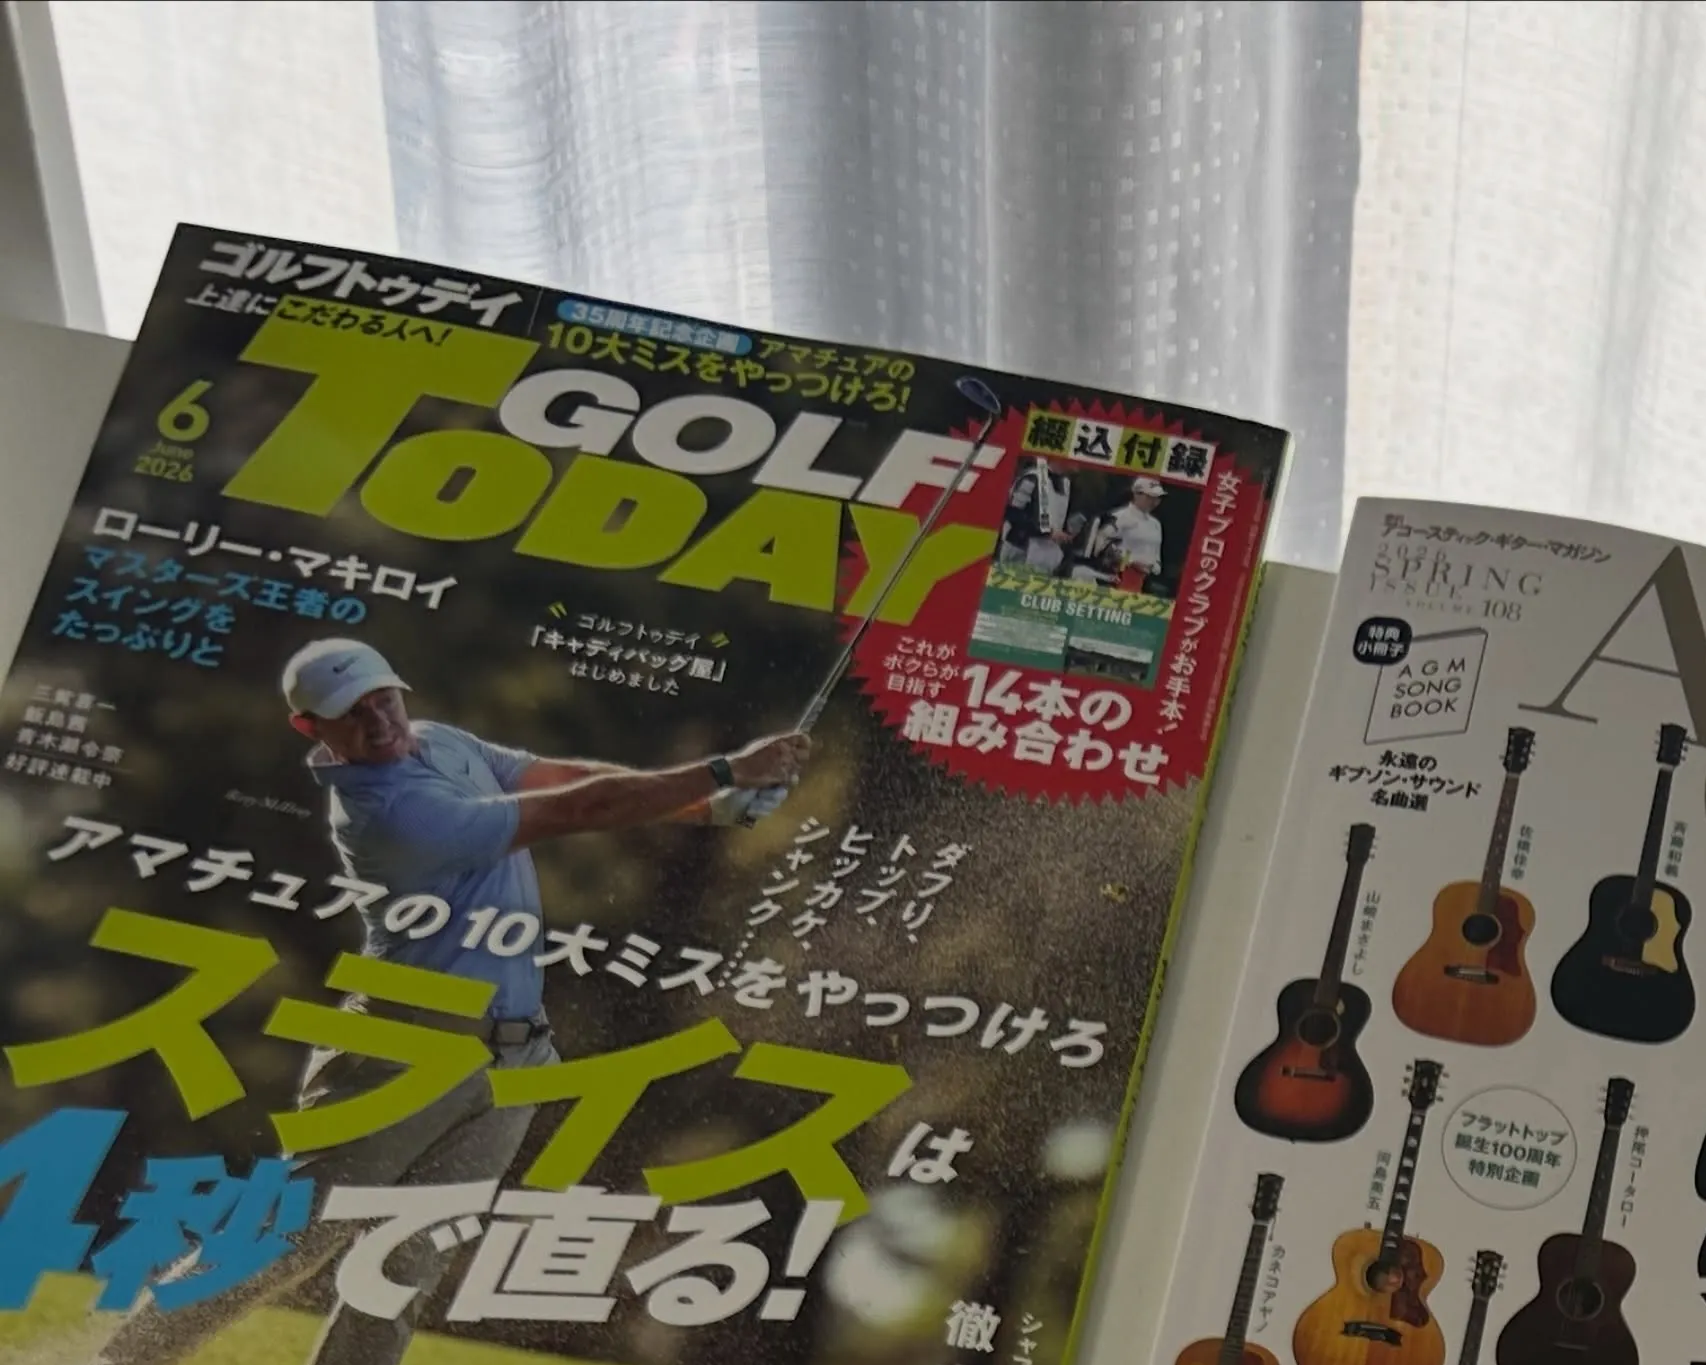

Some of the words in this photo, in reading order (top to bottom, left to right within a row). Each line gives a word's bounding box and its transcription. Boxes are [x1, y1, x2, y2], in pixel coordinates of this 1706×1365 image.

[198, 239, 523, 328] ゴルフトゥデイ
[157, 379, 211, 441] 6
[499, 369, 1005, 509] GOLF
[1024, 412, 1215, 482] 綴込付録
[134, 457, 194, 483] 2026
[221, 294, 1000, 627] TODAY
[92, 506, 458, 610] ローリー・マキロイ
[1374, 557, 1544, 598] SPRING
[66, 577, 237, 635] スイングを
[84, 545, 366, 626] マスターズ王者の
[1021, 595, 1061, 613] CLUB
[1065, 603, 1132, 626] SETTING
[1482, 599, 1523, 622] 108
[52, 609, 226, 668] たっぷりと
[897, 637, 957, 661] これが
[570, 662, 680, 695] はじめました
[883, 654, 960, 683] ボクらが
[886, 675, 946, 699] 目指す
[1394, 677, 1463, 700] SONG
[961, 664, 1133, 731] 14本の
[1390, 696, 1457, 720] BOOK
[903, 700, 1169, 784] 組み合わせ
[1379, 750, 1437, 772] 永遠の
[48, 815, 1107, 1068] アマチュアの10大ミスをやっつけろ
[1460, 1112, 1569, 1147] フラットトップ
[1467, 1160, 1541, 1189] 特別企画
